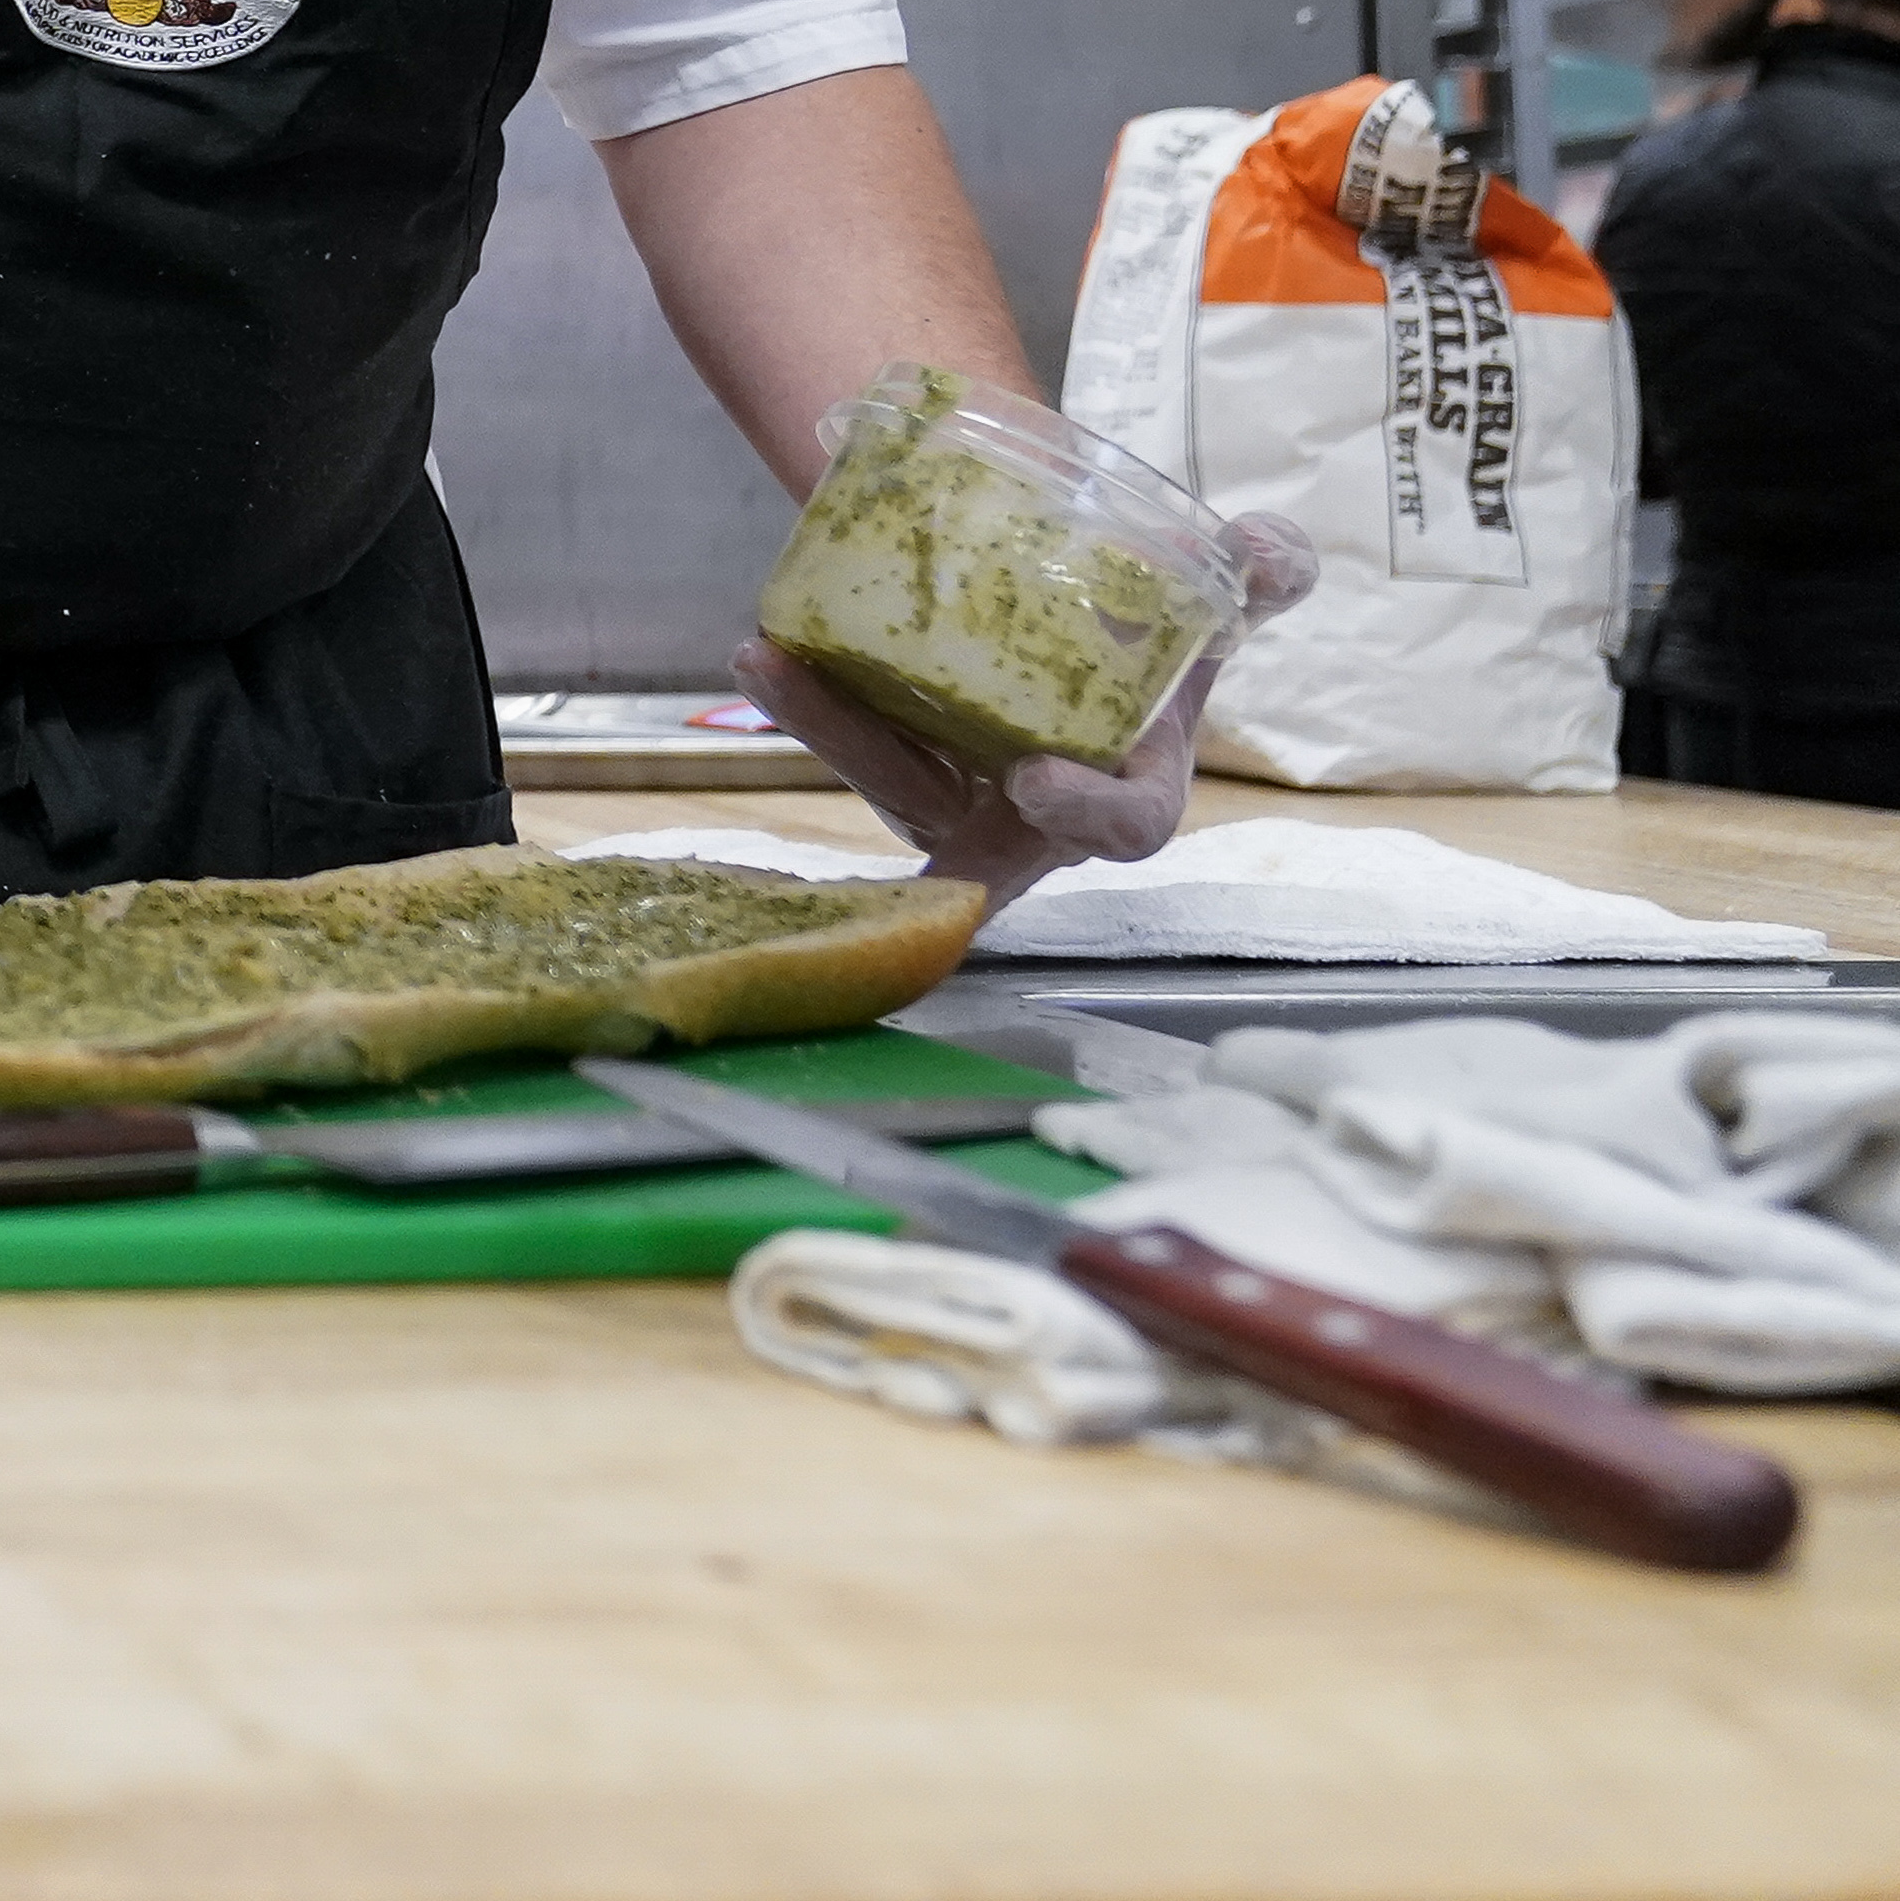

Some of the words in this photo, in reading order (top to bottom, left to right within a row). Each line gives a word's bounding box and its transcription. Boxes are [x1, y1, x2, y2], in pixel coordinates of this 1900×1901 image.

[71, 20, 165, 48] NUTRITION
[169, 14, 260, 48] SERVICES
[112, 46, 184, 62] ACADEMIC
[185, 26, 269, 62] EXCELLENCE
